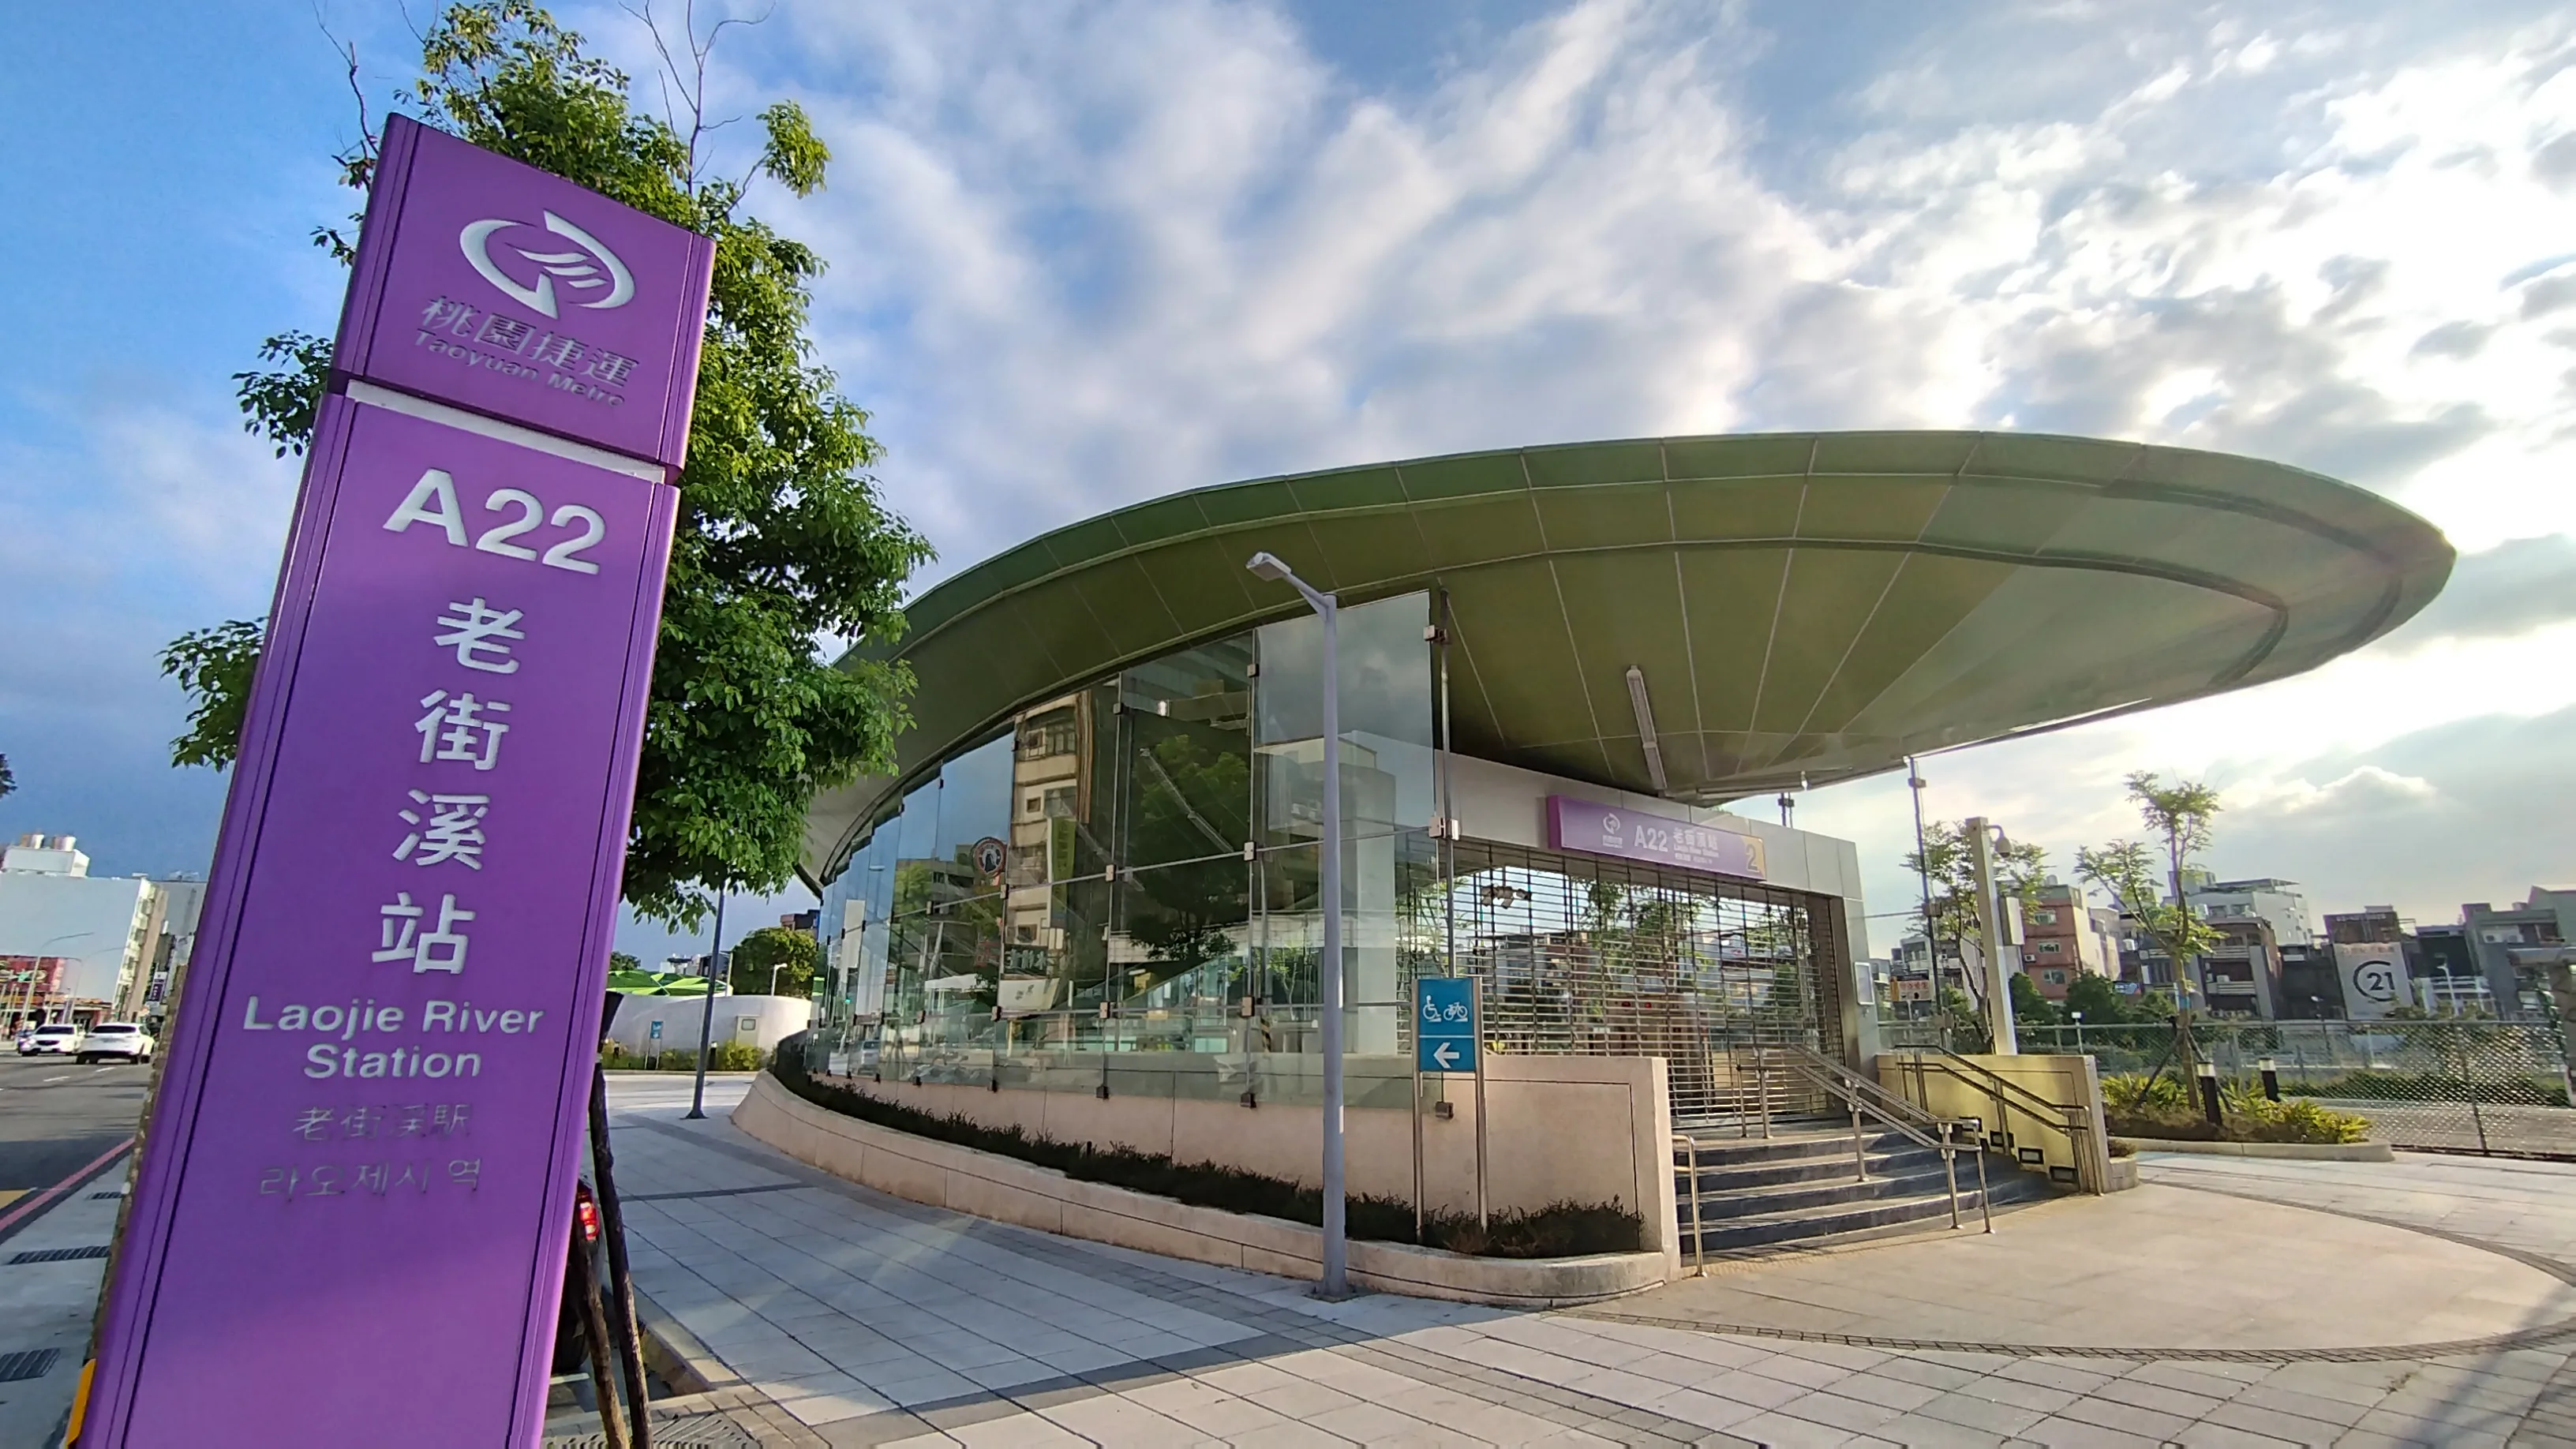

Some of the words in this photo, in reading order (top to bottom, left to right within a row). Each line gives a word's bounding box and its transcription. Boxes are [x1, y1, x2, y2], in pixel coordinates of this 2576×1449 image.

[421, 296, 640, 388] 桃園捷運
[414, 328, 540, 381] Taoyuan
[548, 370, 626, 407] Metro
[382, 467, 607, 575] A22
[372, 597, 526, 975] 老街溪站
[1634, 825, 1669, 852] A22
[1745, 843, 1760, 873] 2
[2367, 972, 2395, 990] 21
[243, 996, 404, 1040] Laojie
[422, 1000, 545, 1033] River
[304, 1043, 482, 1079] Station
